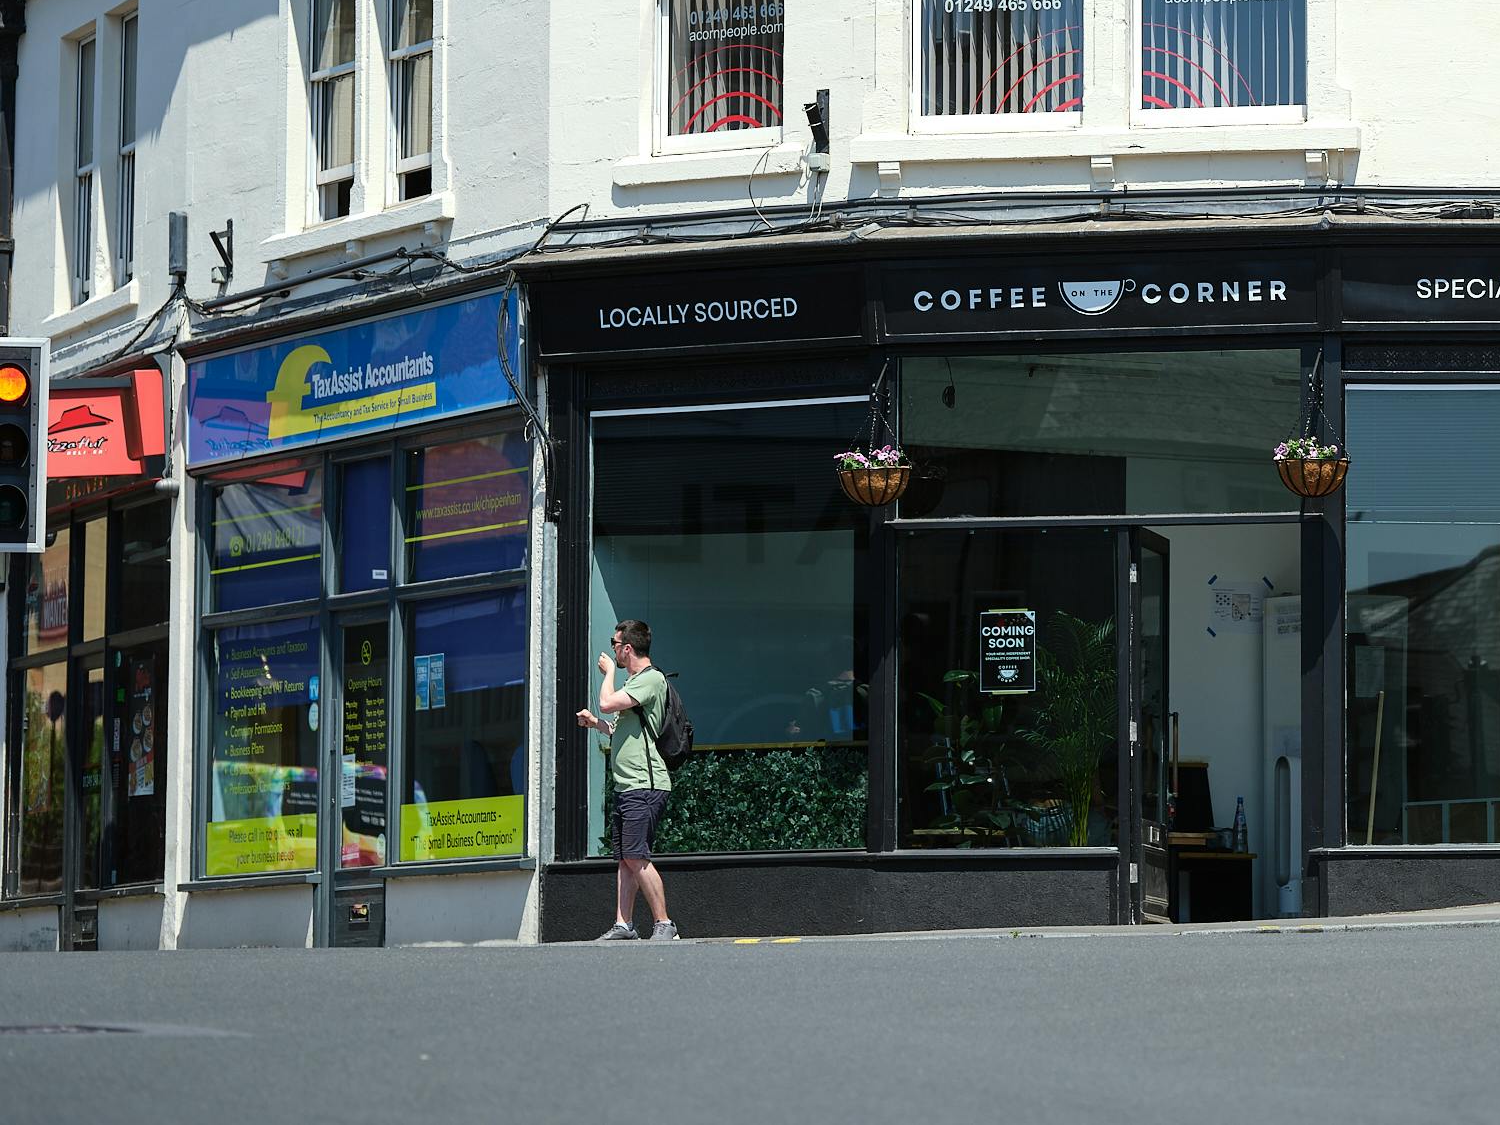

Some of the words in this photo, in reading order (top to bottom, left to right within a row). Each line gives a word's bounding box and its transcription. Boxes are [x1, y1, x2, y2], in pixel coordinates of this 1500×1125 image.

[690, 7, 729, 25] 01249
[733, 6, 755, 20] 465
[760, 3, 783, 18] 666
[690, 22, 784, 42] acornpeople.com
[914, 287, 1047, 312] COFFEE
[1142, 281, 1287, 304] CORNER
[600, 304, 690, 329] LOCALLY
[694, 297, 798, 322] SOURCED
[312, 366, 362, 399] TaxAssist
[365, 351, 434, 388] Accountants
[78, 436, 108, 450] Hut
[982, 626, 1034, 637] COMING
[988, 638, 1024, 648] SOON
[426, 811, 455, 827] TaxAssist
[456, 809, 497, 825] Accountants
[446, 833, 474, 849] Business
